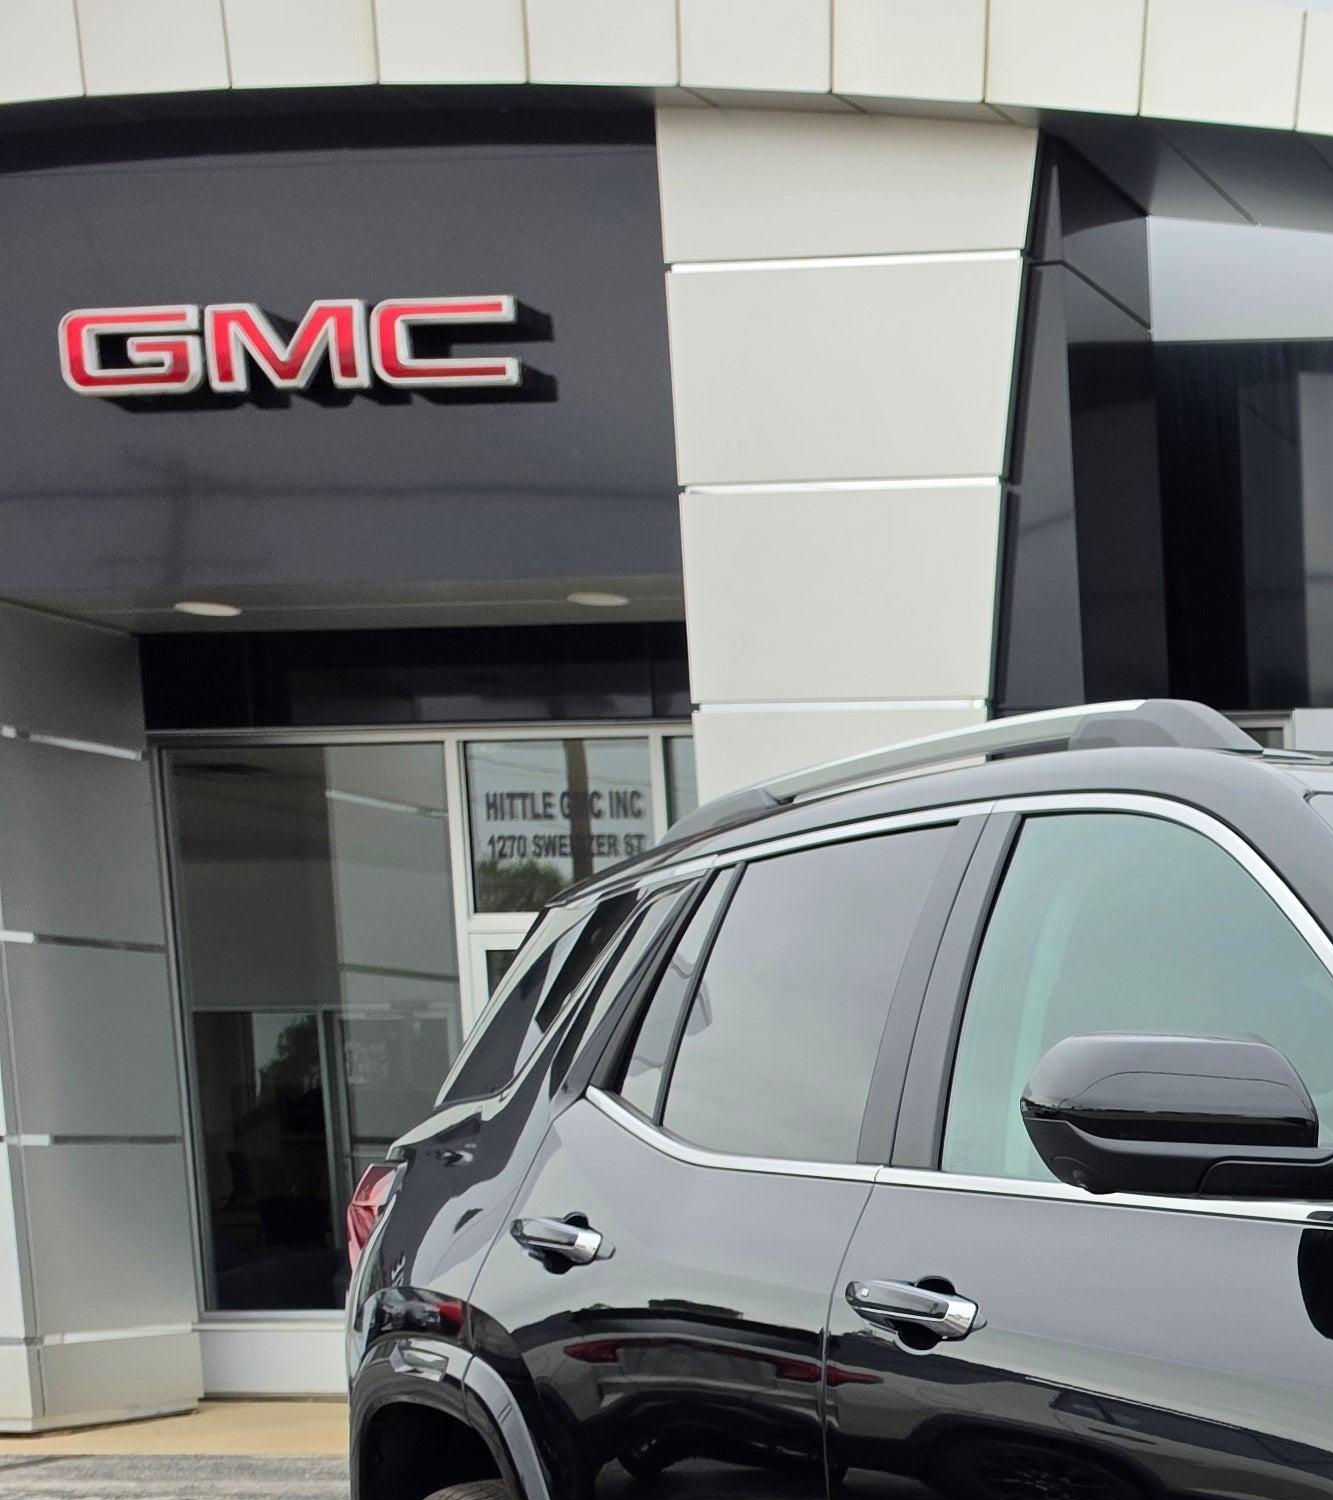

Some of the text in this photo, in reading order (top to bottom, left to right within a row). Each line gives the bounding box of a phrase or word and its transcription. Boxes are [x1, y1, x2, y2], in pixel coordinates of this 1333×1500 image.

[58, 295, 522, 396] GMC
[485, 792, 555, 821] HITTLE
[608, 790, 643, 819] INC
[487, 835, 527, 859] 1270
[624, 834, 646, 857] ST
